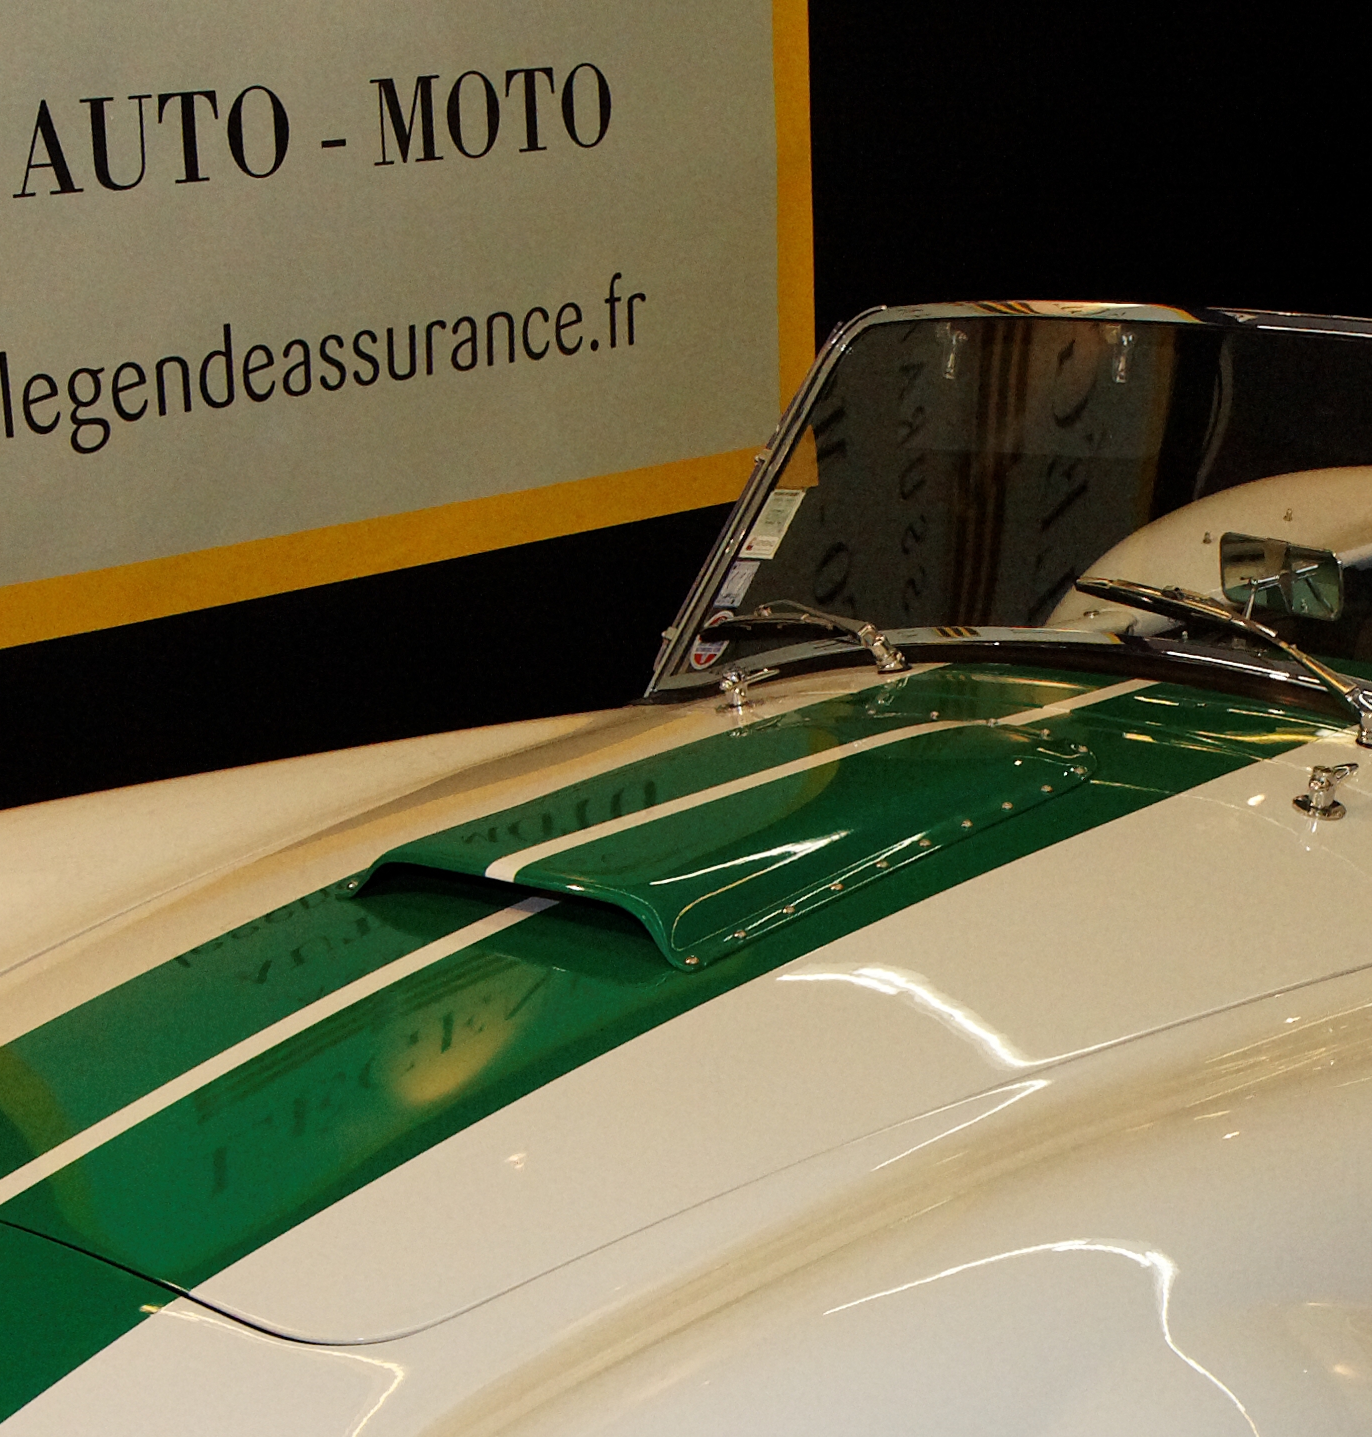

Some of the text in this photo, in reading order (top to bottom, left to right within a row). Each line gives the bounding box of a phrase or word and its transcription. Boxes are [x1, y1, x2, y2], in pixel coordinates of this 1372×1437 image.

[12, 62, 612, 199] AUTO - MOTO
